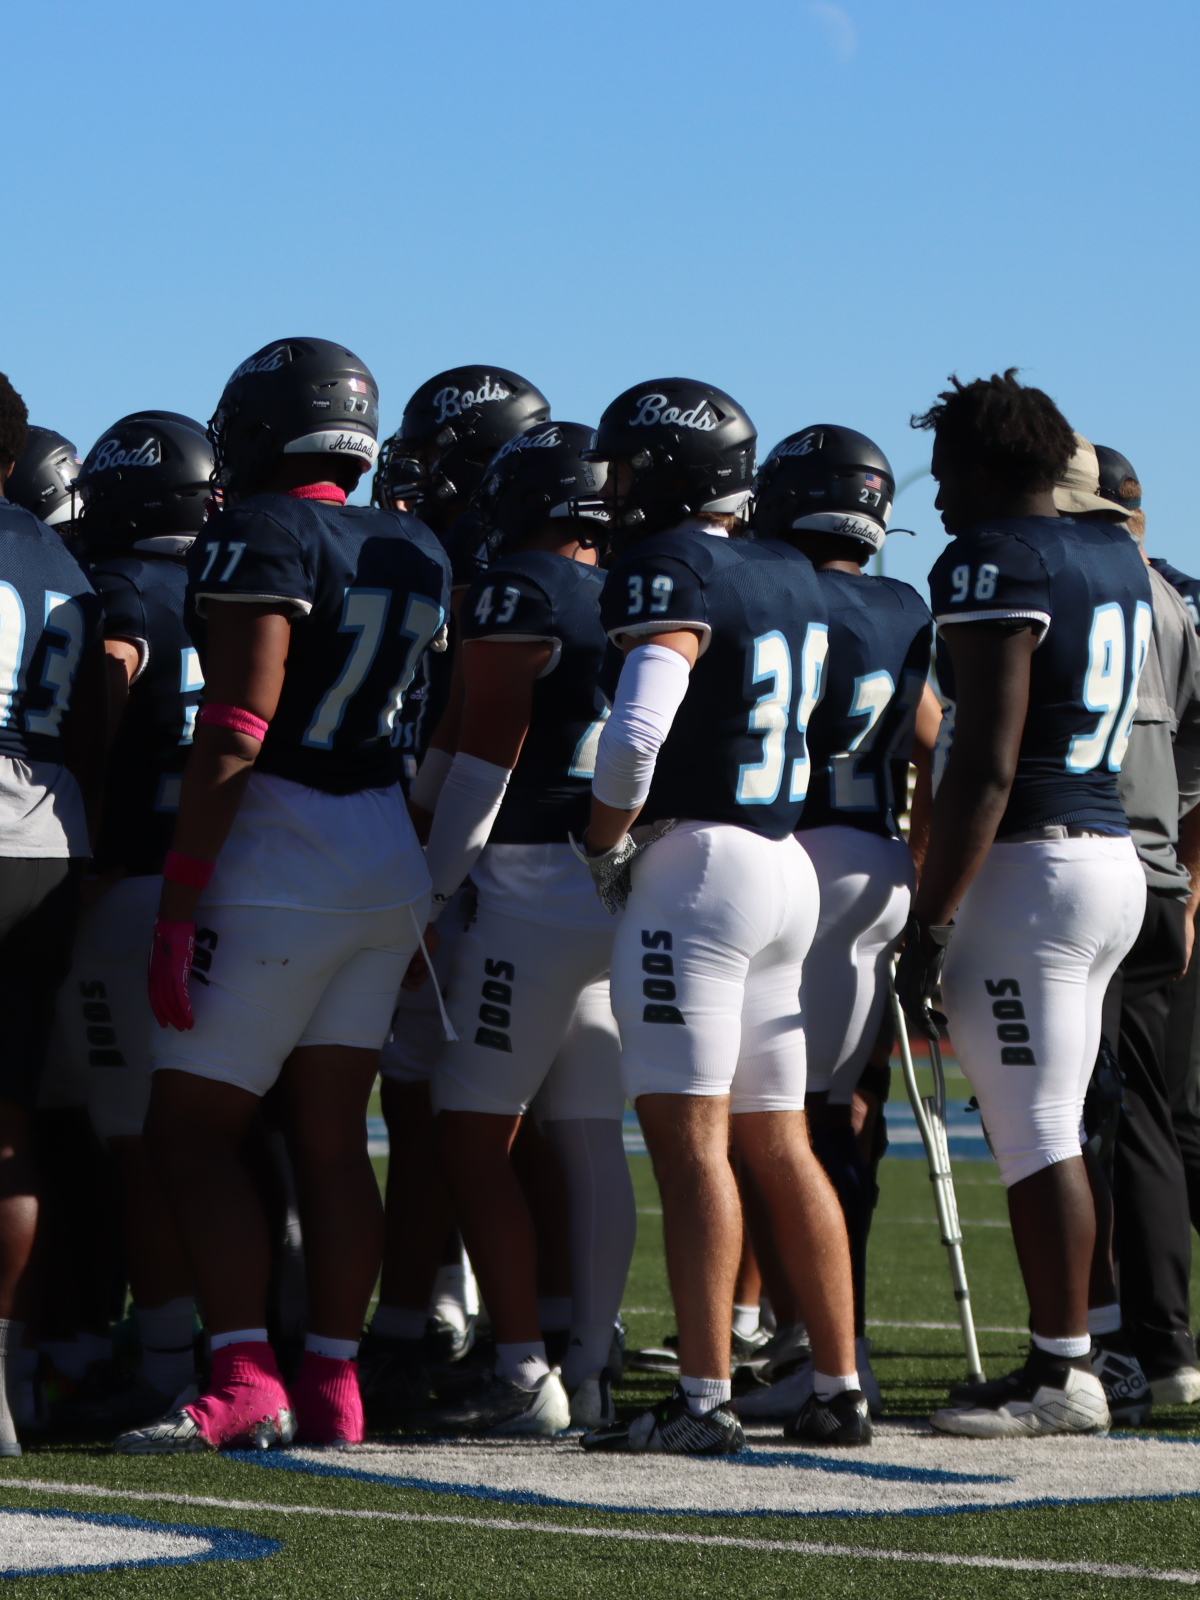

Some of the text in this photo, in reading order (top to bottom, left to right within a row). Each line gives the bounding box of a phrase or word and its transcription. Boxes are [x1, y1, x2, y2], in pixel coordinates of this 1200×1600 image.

[348, 396, 369, 415] 77
[433, 376, 509, 424] Bods
[629, 394, 719, 431] Bods
[88, 438, 160, 474] Bods
[329, 434, 374, 458] Ichabods
[859, 488, 882, 508] 27
[833, 518, 878, 544] Ichabods
[199, 541, 248, 582] 77
[627, 574, 675, 616] 39
[950, 563, 1000, 603] 98
[473, 585, 522, 625] 43
[301, 587, 446, 750] 77
[735, 622, 829, 805] 39
[641, 929, 687, 1026] BODS
[78, 980, 128, 1068] BODS
[474, 957, 515, 1053] BODS
[983, 978, 1037, 1067] BODS
